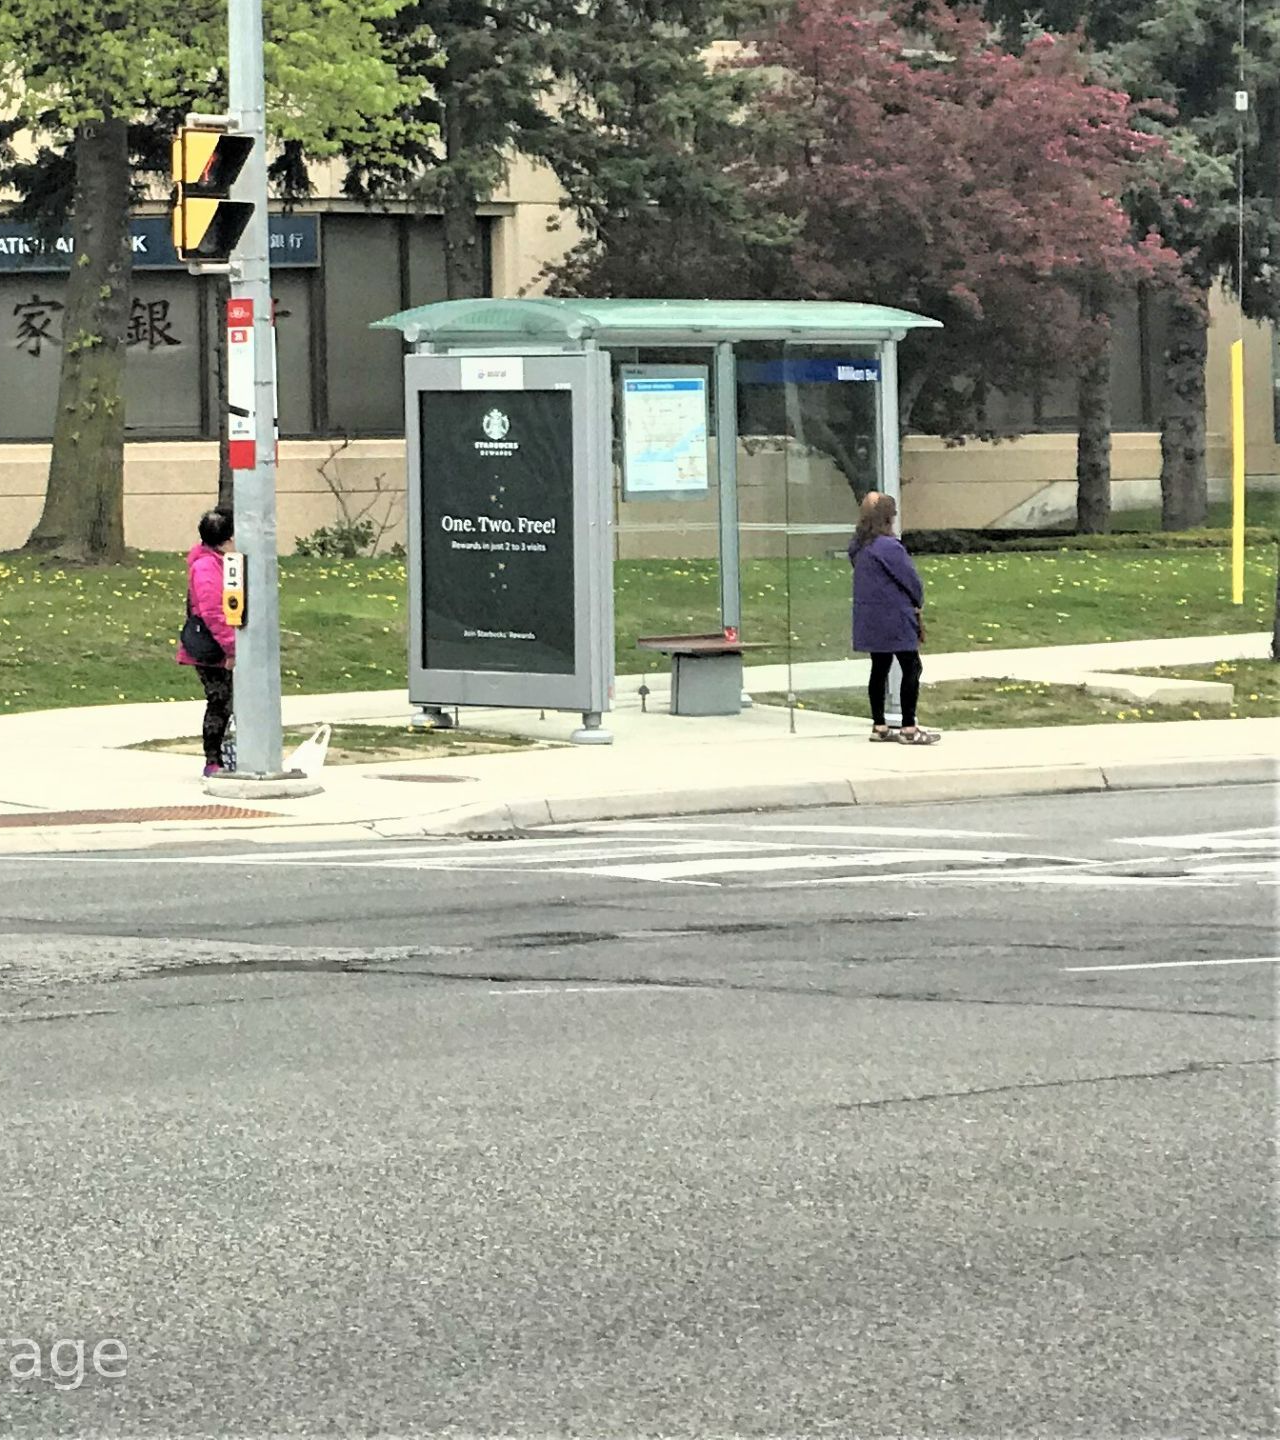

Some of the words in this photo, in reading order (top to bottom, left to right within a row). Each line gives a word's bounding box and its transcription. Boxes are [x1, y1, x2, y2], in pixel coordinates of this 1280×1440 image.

[441, 516, 476, 533] One.
[478, 517, 515, 534] Two.
[518, 517, 556, 534] Free!
[451, 541, 482, 550] Rewards
[490, 542, 504, 552] just
[511, 543, 520, 551] to
